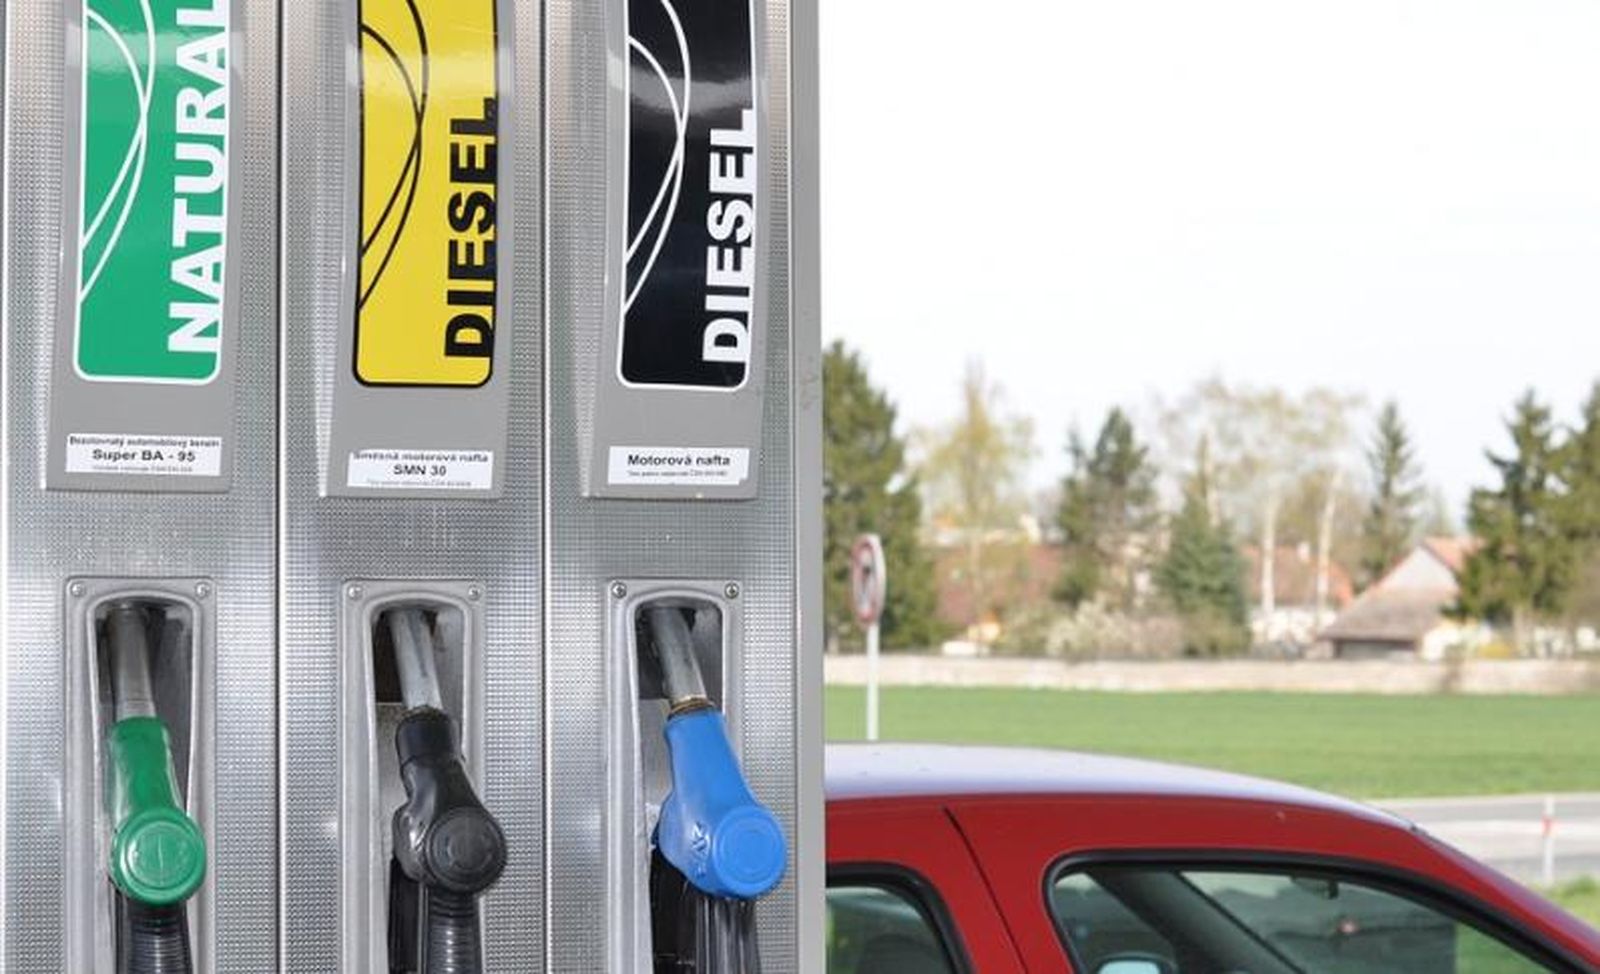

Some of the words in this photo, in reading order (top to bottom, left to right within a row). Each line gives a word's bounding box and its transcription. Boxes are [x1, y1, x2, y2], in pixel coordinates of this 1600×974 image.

[168, 0, 229, 352] NATURAL
[444, 97, 497, 357] DIESEL
[702, 109, 757, 362] DIESEL
[92, 449, 137, 462] Super
[141, 450, 164, 462] BA
[177, 450, 196, 462] 95
[393, 464, 427, 475] SMN
[430, 464, 447, 476] 30
[627, 454, 692, 466] Motorová
[696, 454, 731, 466] nafta
